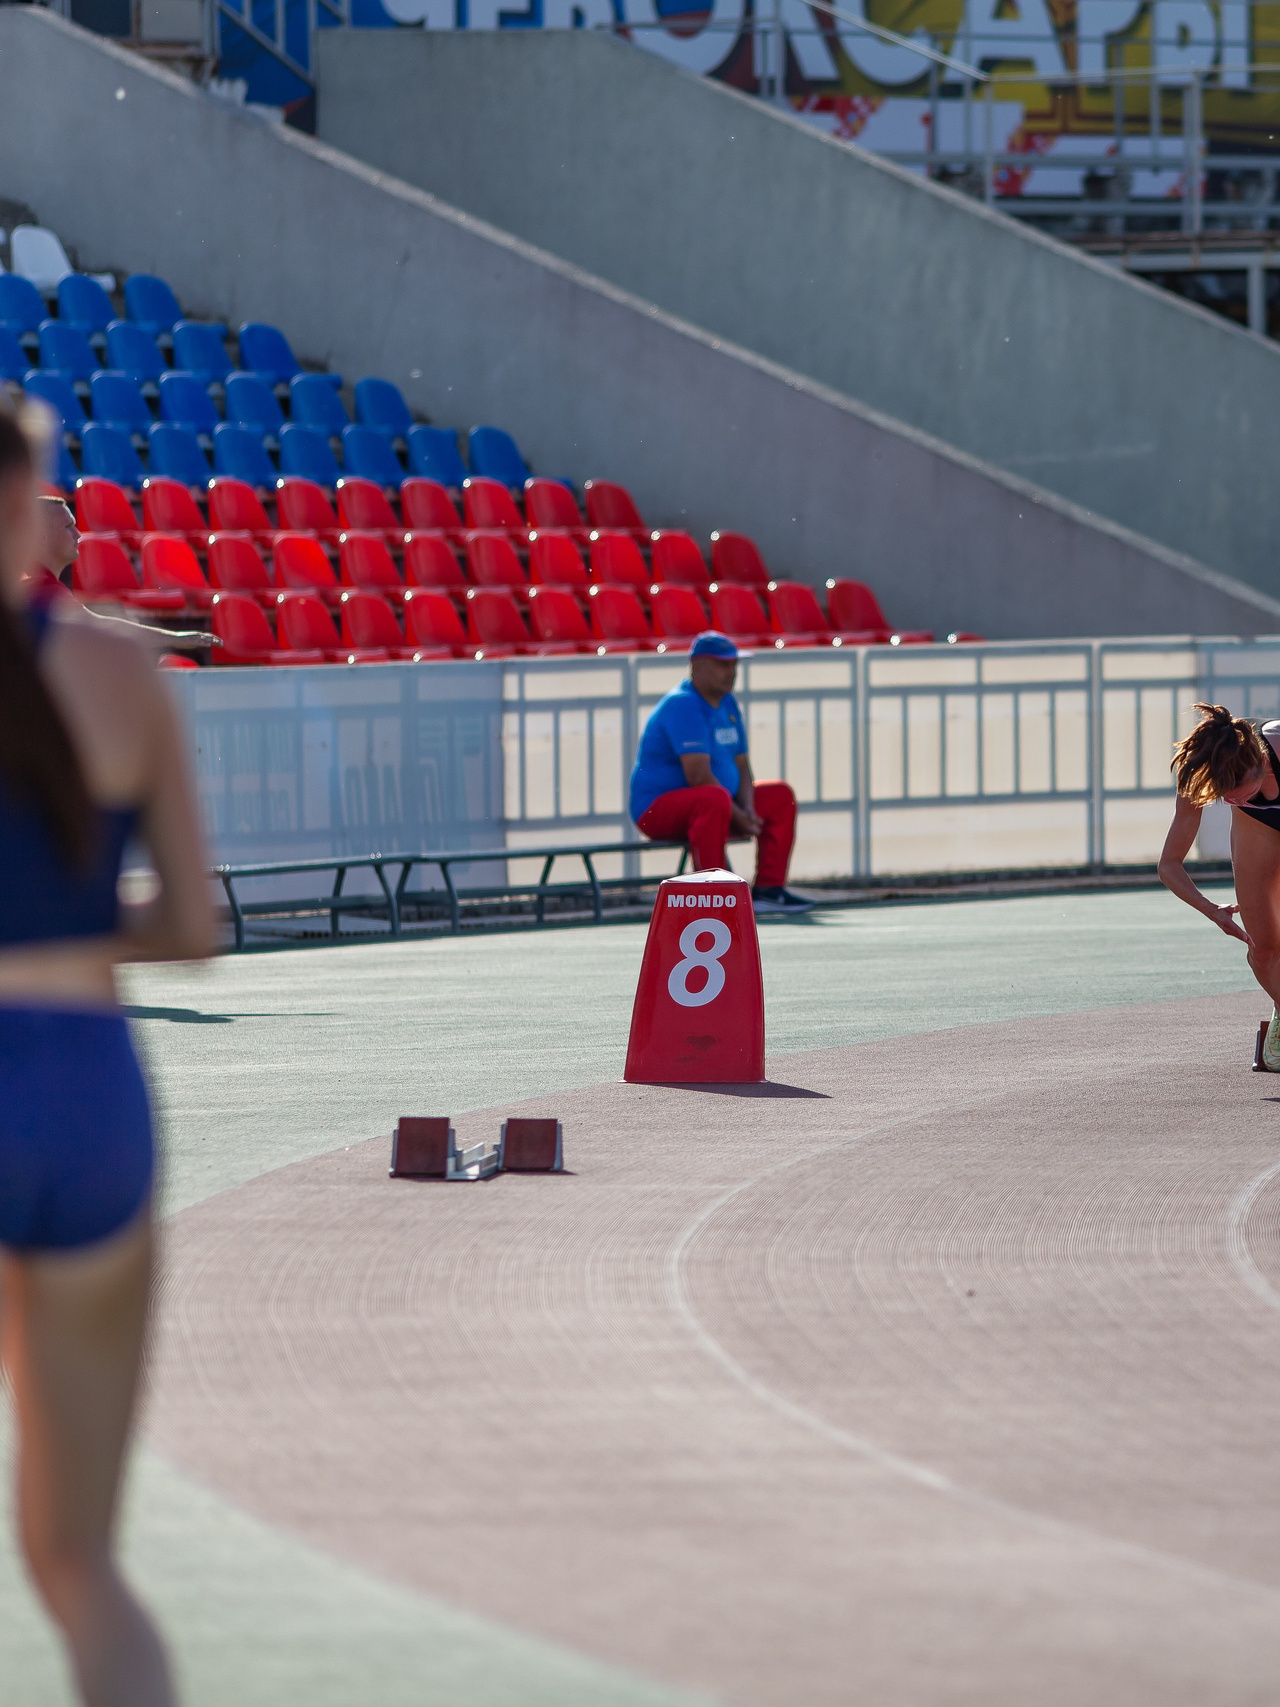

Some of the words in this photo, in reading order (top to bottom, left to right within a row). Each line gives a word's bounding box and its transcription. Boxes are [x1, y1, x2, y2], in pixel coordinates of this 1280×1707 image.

[382, 0, 1250, 89] ОКСАРЫ
[667, 894, 737, 908] MONDO
[667, 918, 732, 1007] 8
